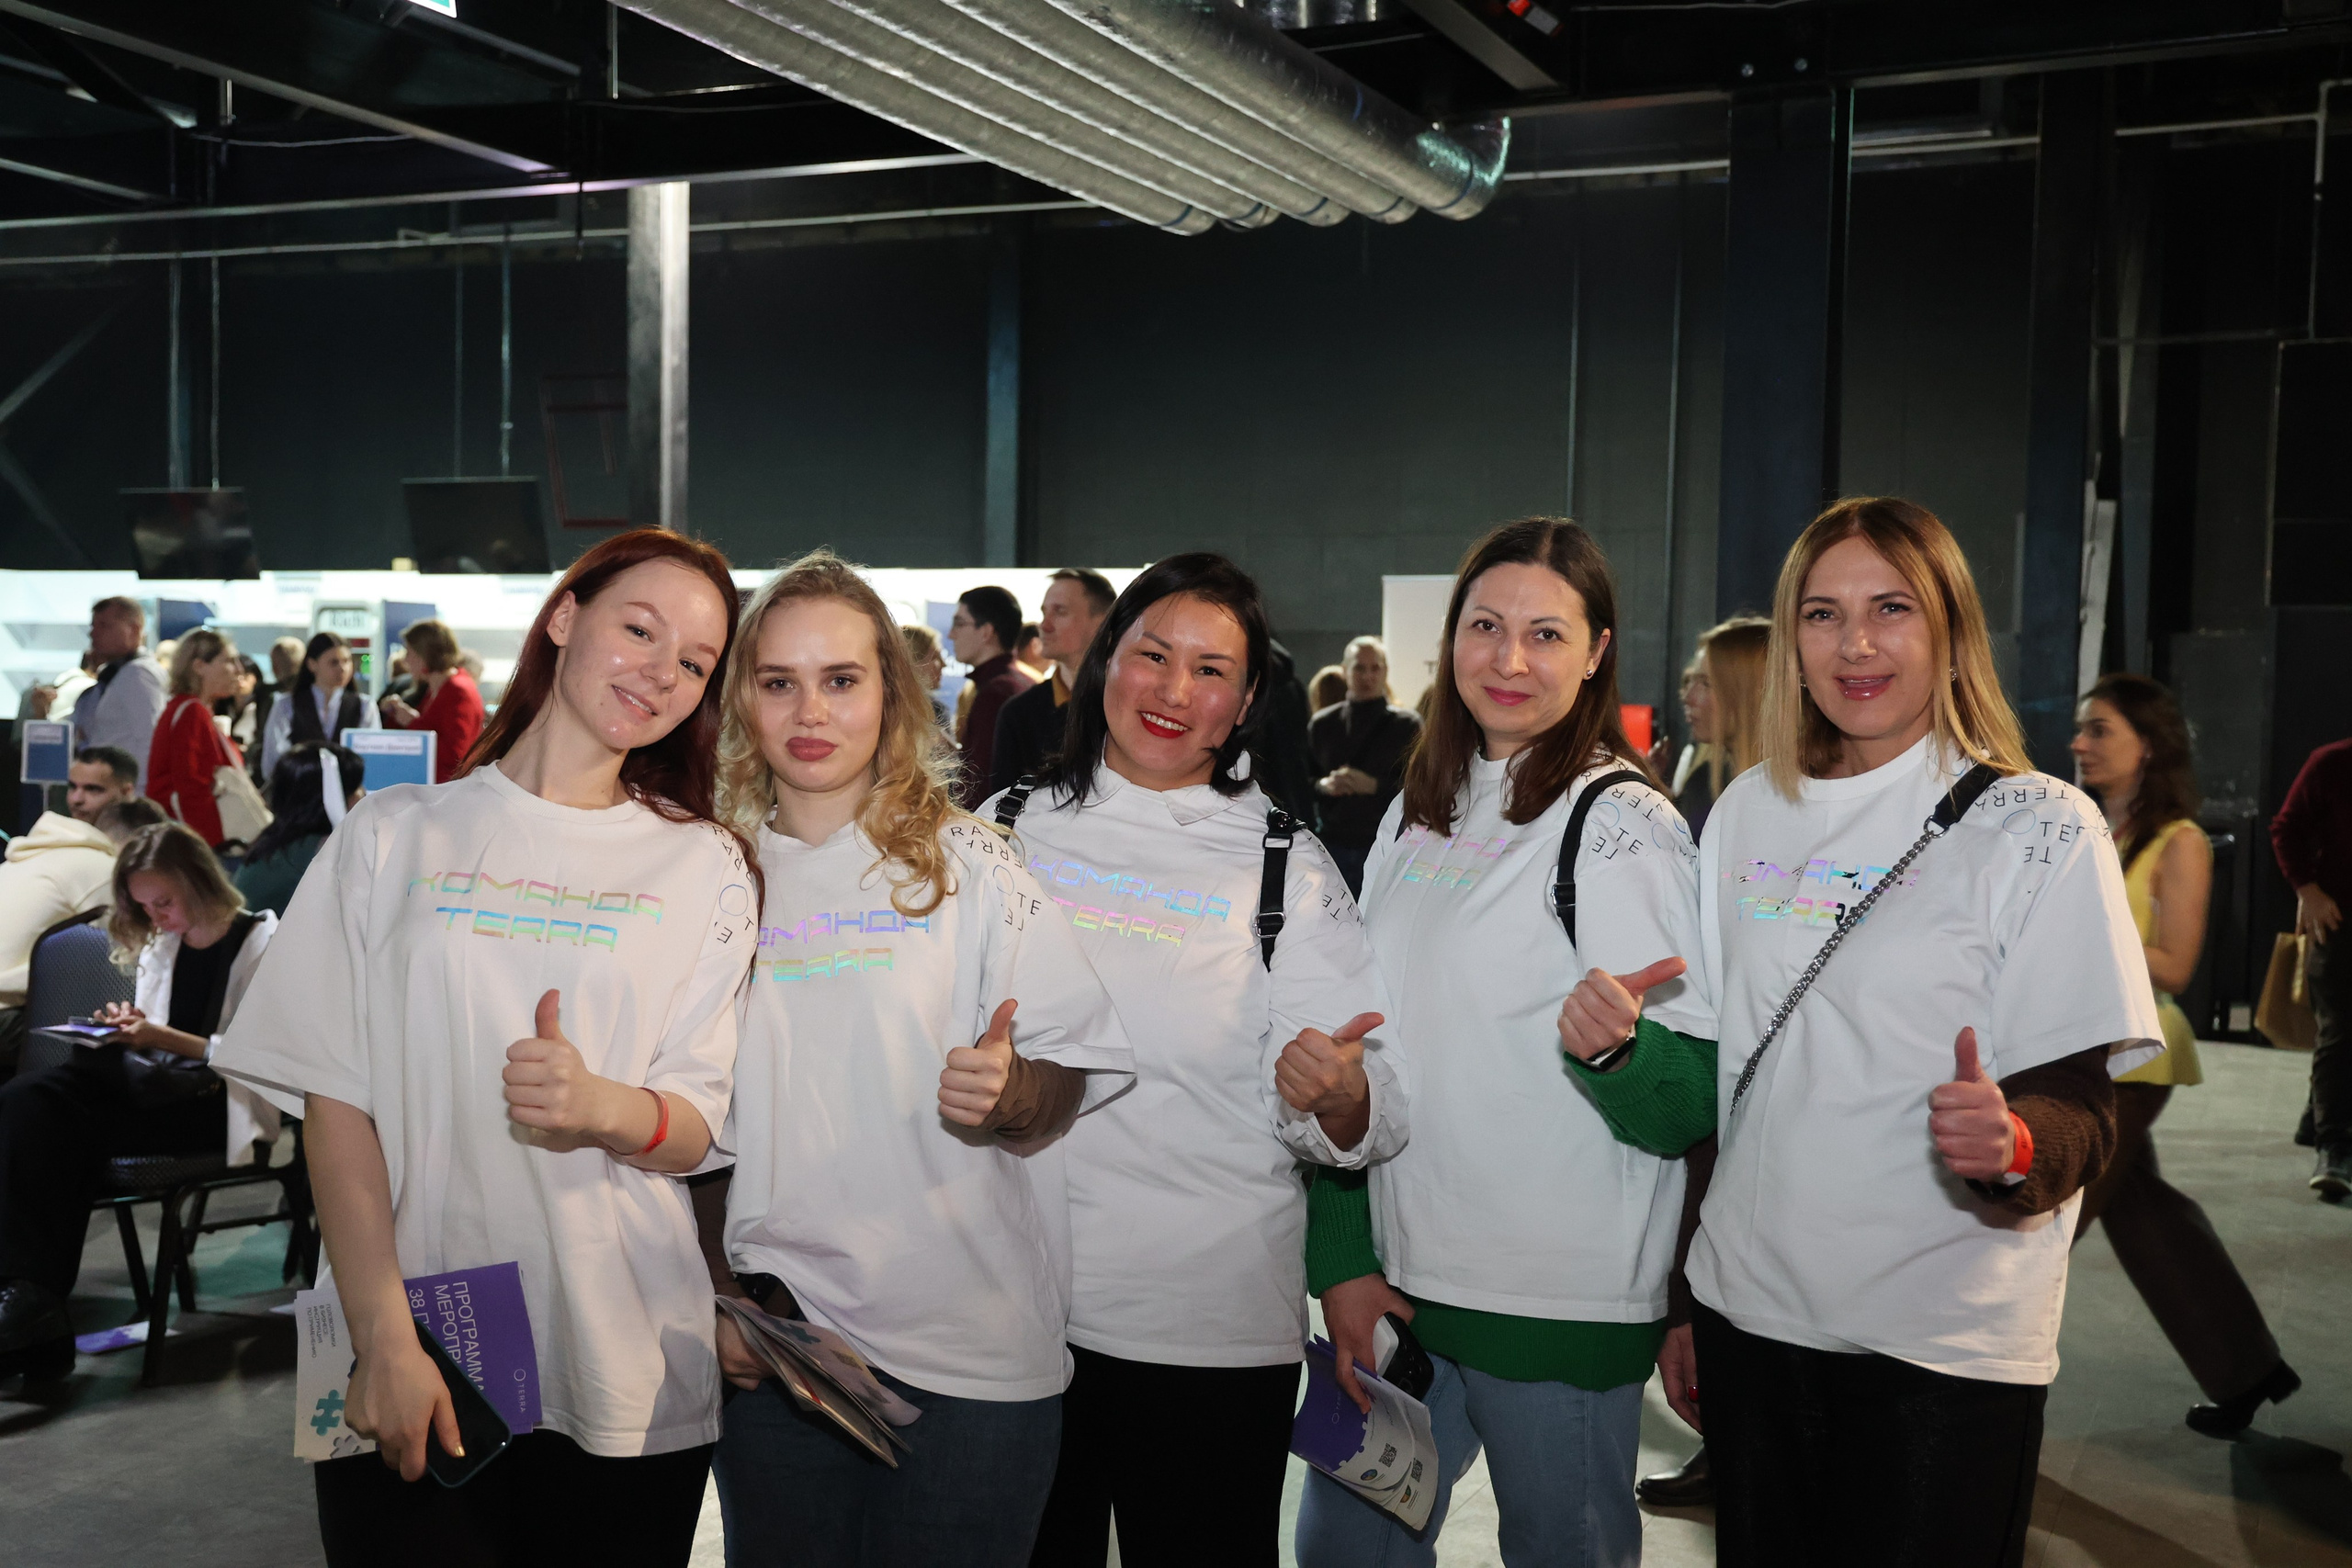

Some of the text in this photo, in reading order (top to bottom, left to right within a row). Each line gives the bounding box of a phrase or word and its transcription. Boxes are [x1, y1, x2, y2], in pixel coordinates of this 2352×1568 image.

[408, 871, 665, 925] КОМАНДА
[1029, 854, 1232, 922] КОМАНДА
[435, 906, 618, 953] TERRA
[1052, 896, 1186, 948] TERRA
[409, 1288, 425, 1309] 38
[434, 1284, 462, 1364] МЕРОПР
[518, 1383, 526, 1412] TERRA
